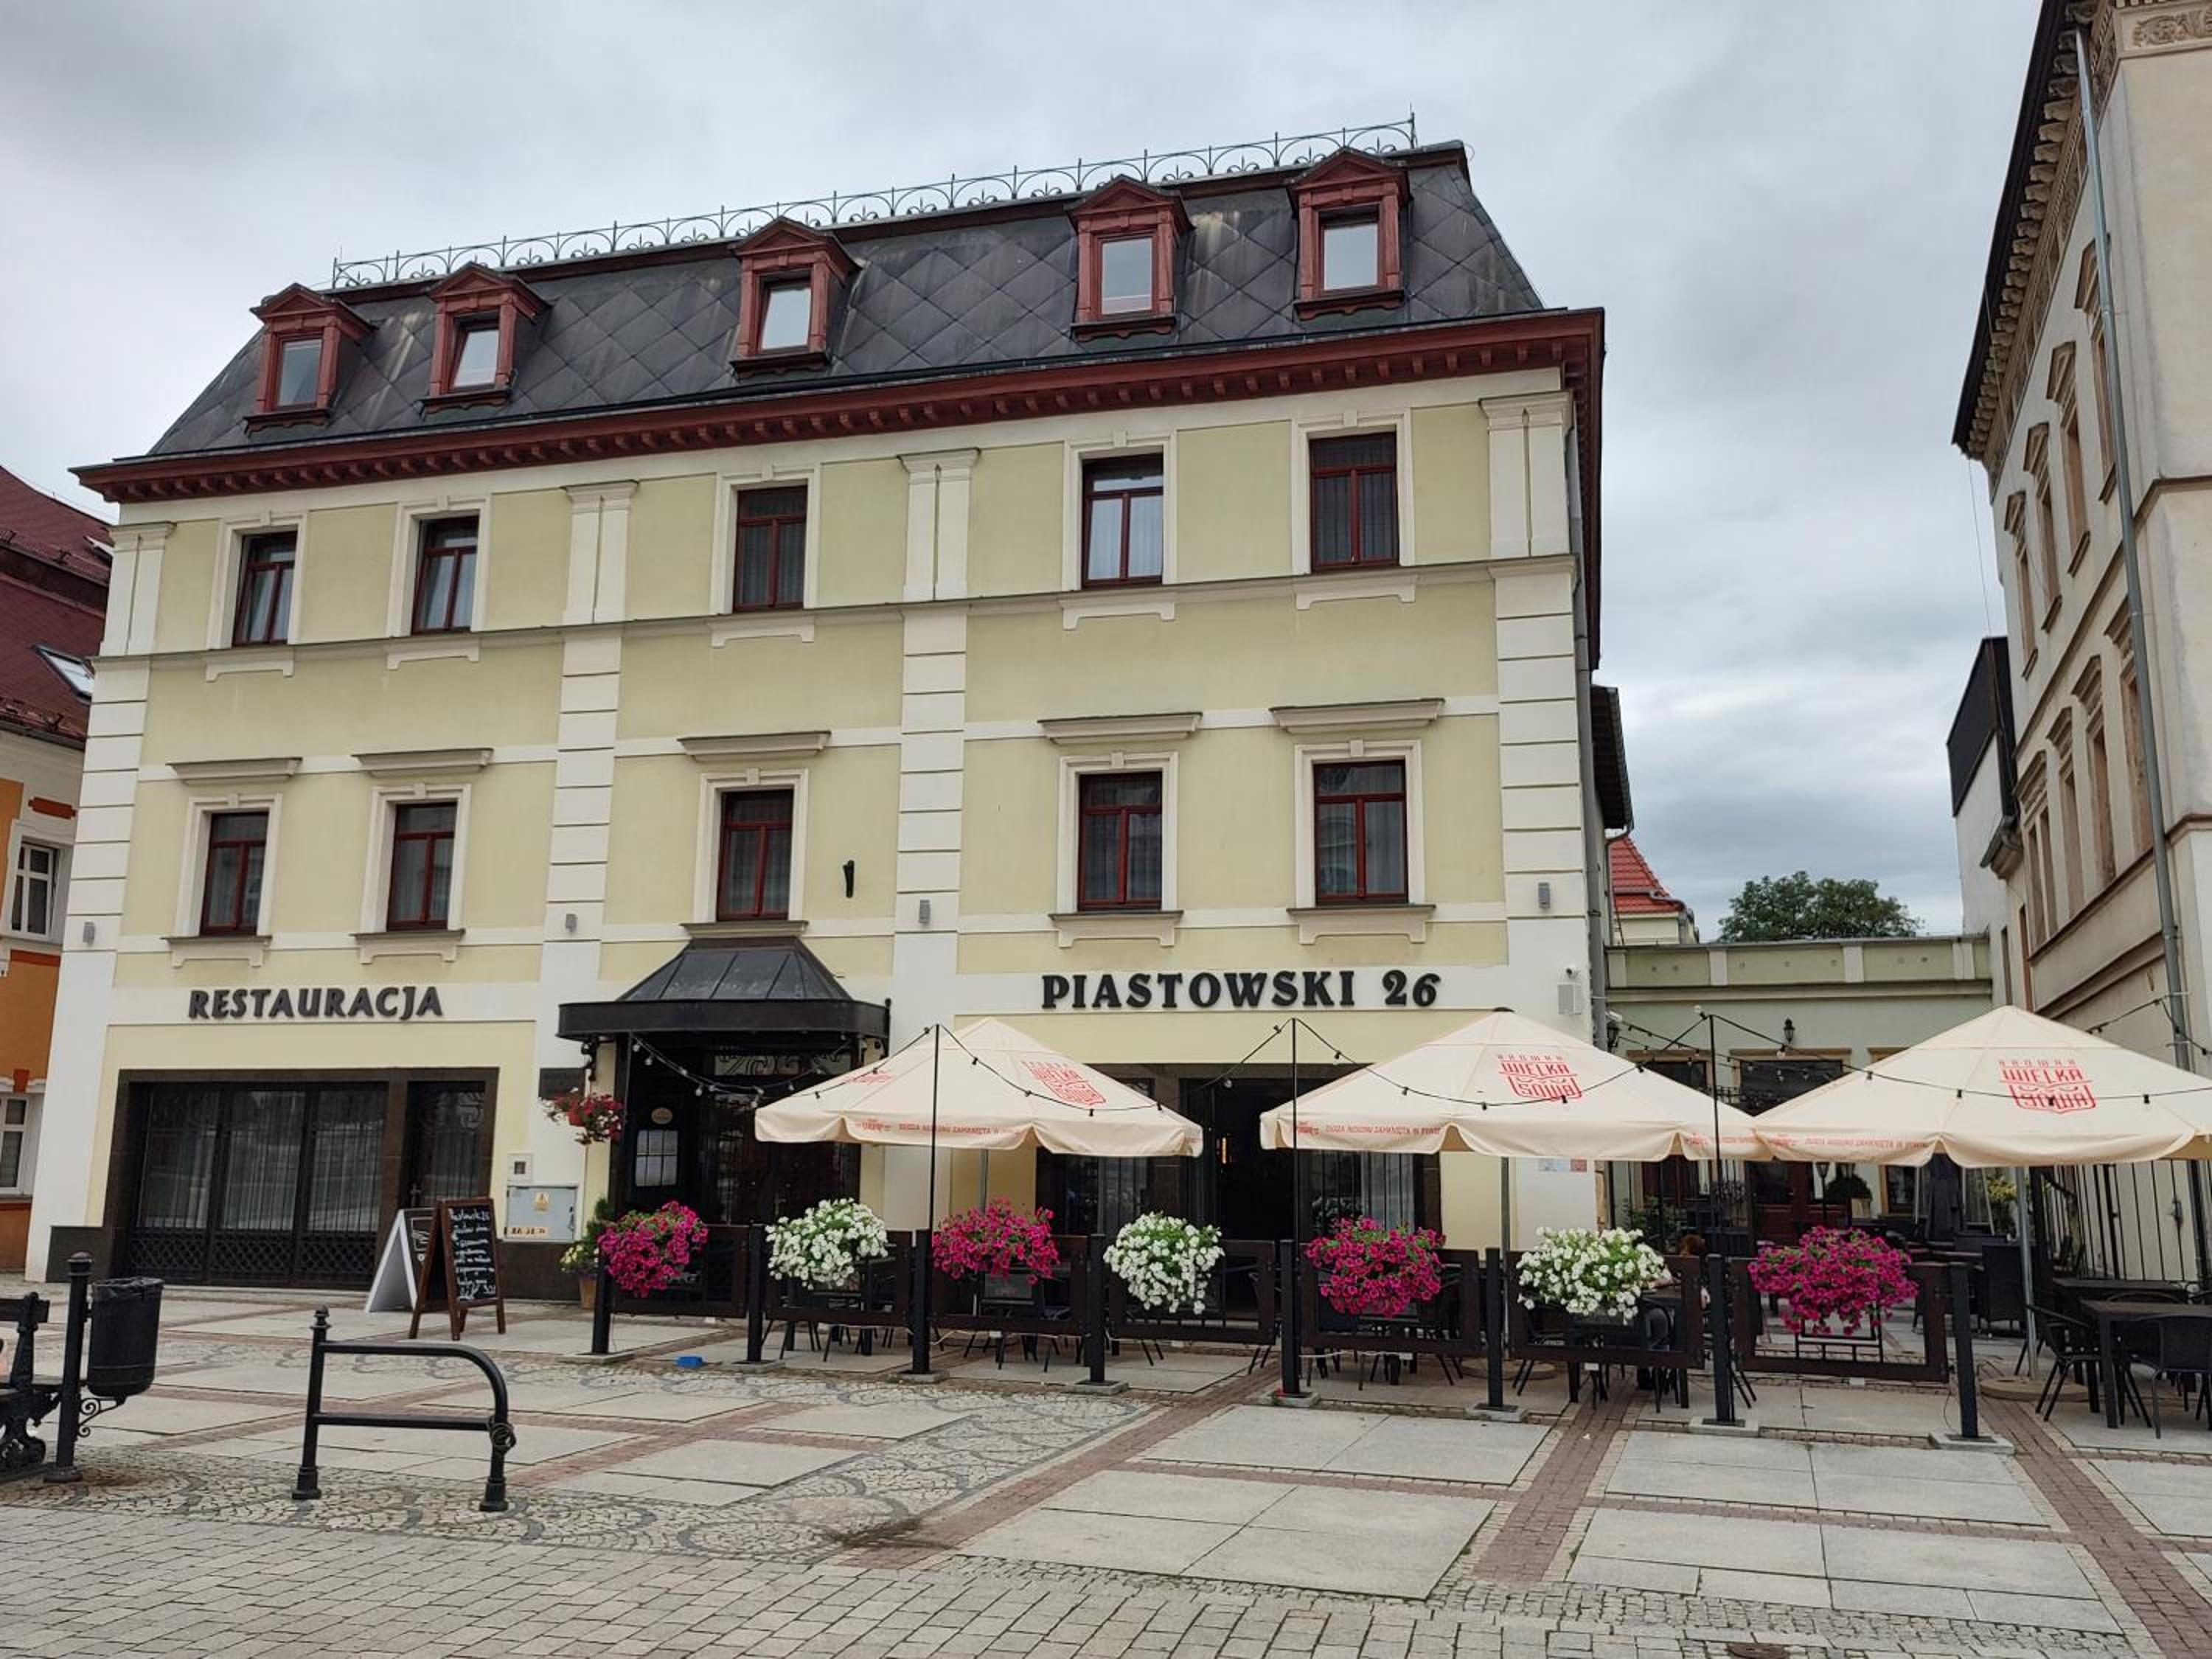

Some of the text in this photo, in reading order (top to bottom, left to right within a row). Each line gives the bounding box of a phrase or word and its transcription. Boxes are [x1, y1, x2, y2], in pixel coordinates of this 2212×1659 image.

[1041, 969, 1441, 1009] PIASTOWSKI 26
[188, 986, 444, 1020] RESTAURACJA
[1500, 1062, 1570, 1077] WIELKA
[2002, 1068, 2084, 1084] WIELKA
